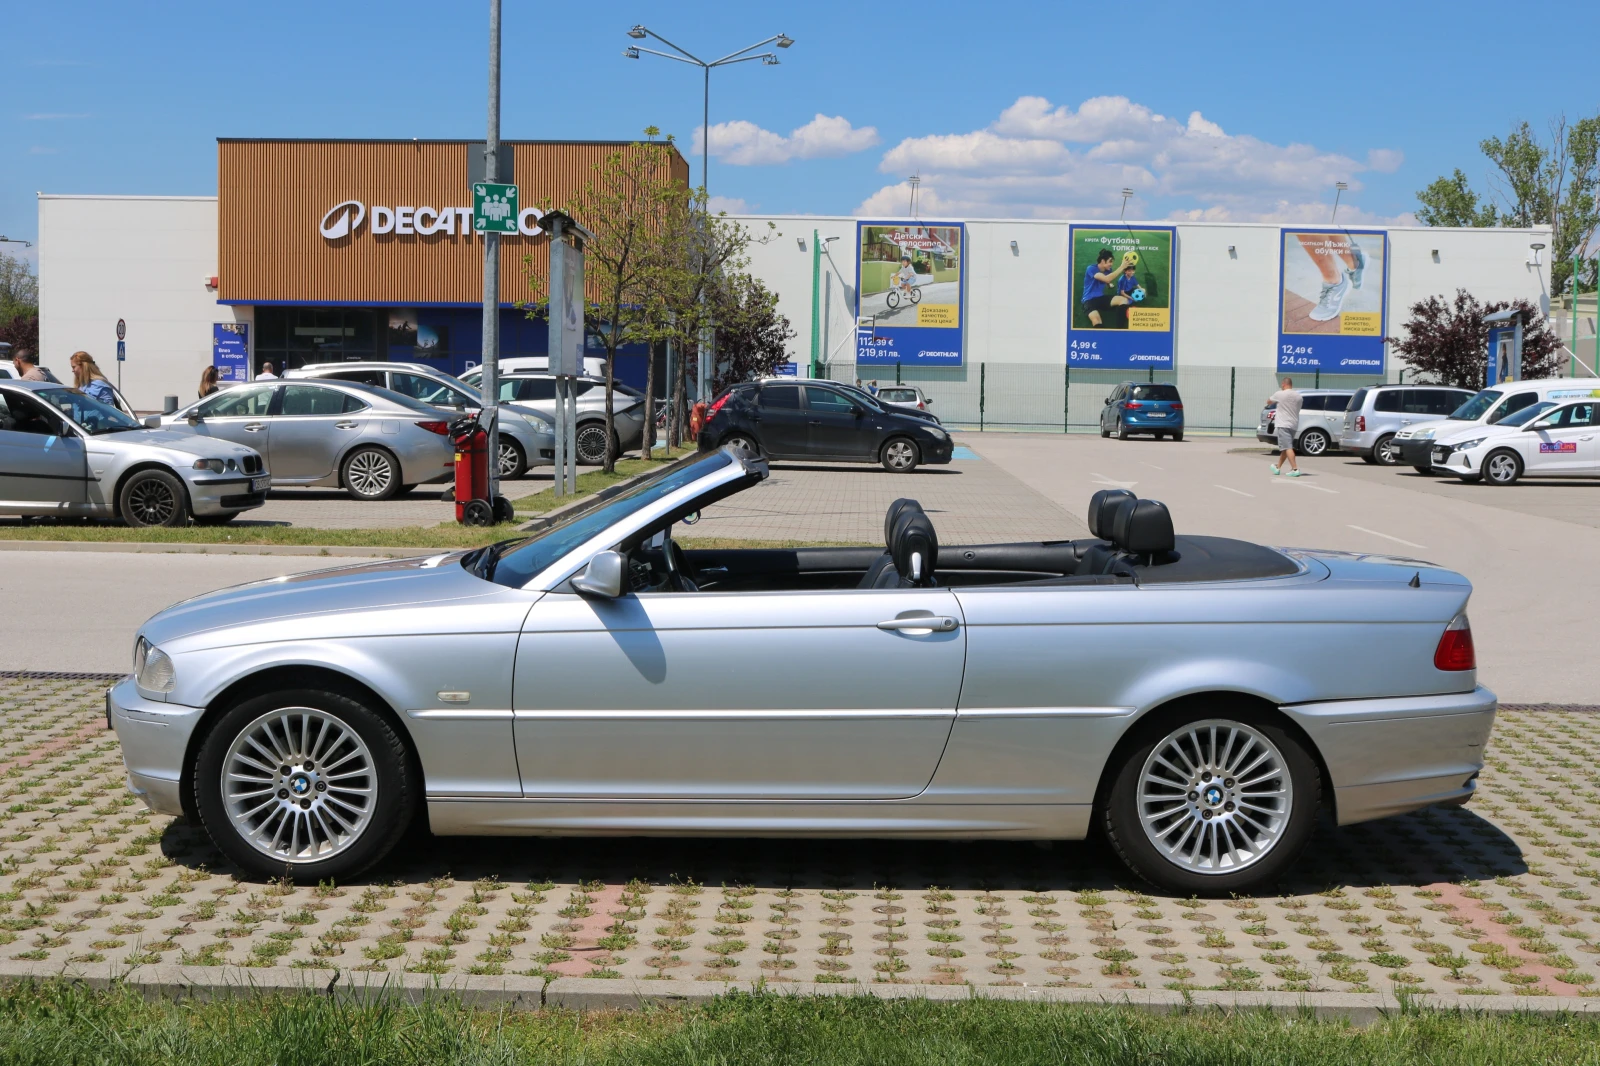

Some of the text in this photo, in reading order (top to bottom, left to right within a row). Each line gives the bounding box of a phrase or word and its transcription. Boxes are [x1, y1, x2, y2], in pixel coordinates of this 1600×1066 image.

[371, 205, 568, 236] DECATO
[894, 232, 924, 240] Детски
[1100, 236, 1140, 245] Футболна
[1314, 248, 1344, 256] обувки
[858, 336, 886, 347] 112,39
[1070, 340, 1090, 350] 4,99
[858, 348, 887, 358] 219,81
[1282, 344, 1306, 354] 12,49
[1070, 351, 1089, 360] 9,76
[1282, 356, 1307, 366] 24,43
